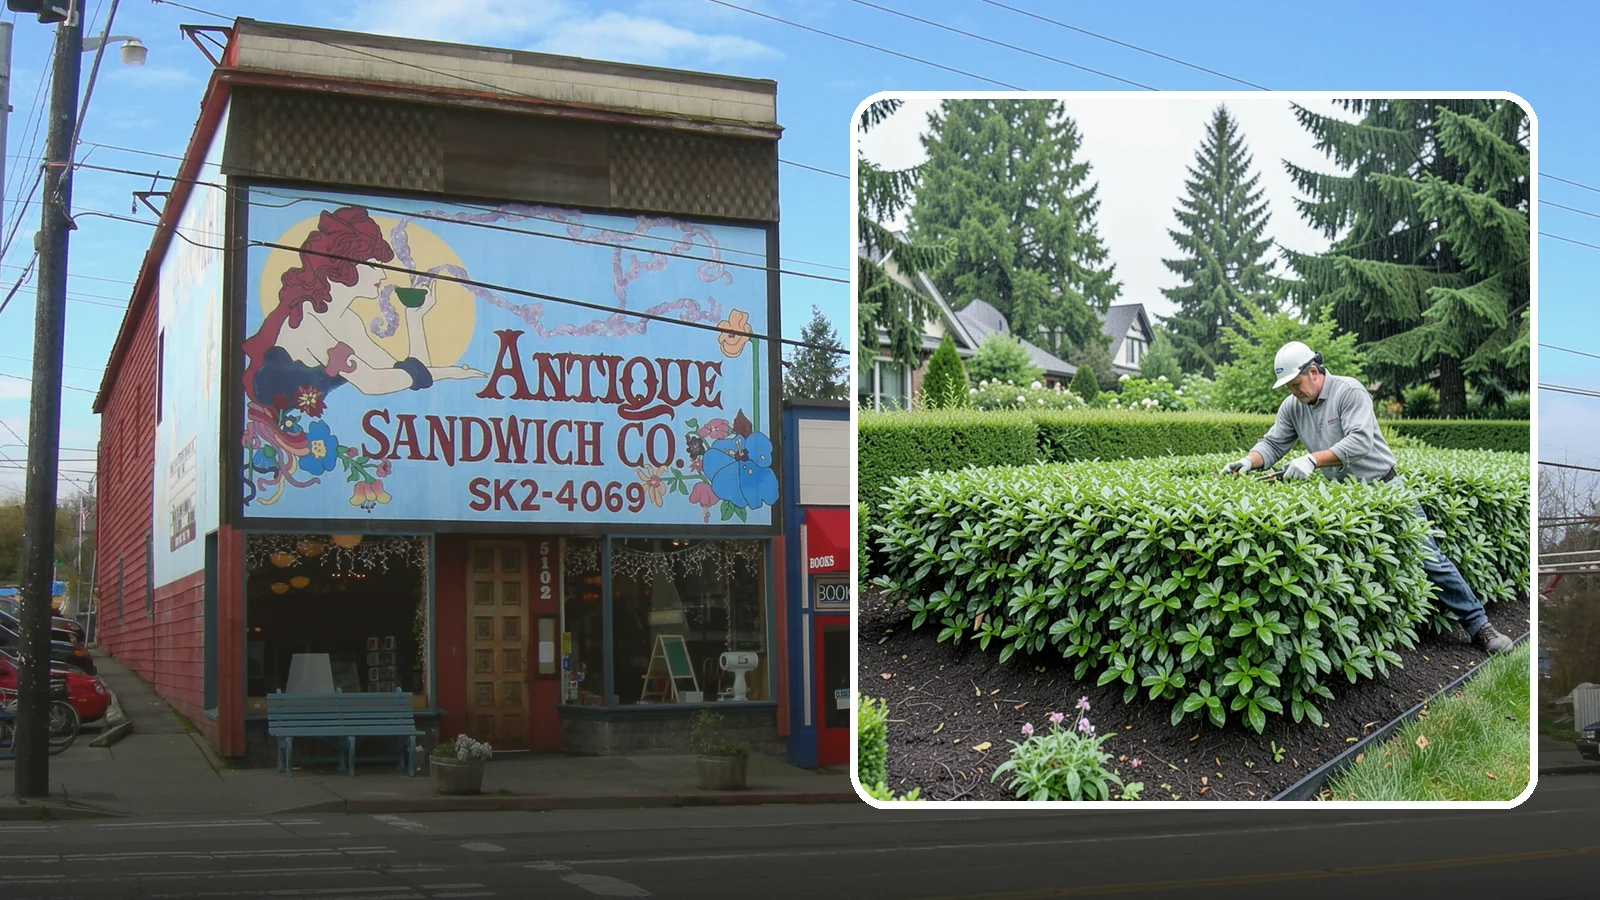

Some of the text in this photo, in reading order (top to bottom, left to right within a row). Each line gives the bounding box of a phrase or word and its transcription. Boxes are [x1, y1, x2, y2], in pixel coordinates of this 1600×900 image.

[475, 329, 724, 421] ANTIQUE
[361, 408, 685, 468] SANDWICH CO.
[469, 477, 646, 513] SK2-4069
[539, 541, 552, 600] 5102
[809, 555, 836, 569] BOOKS
